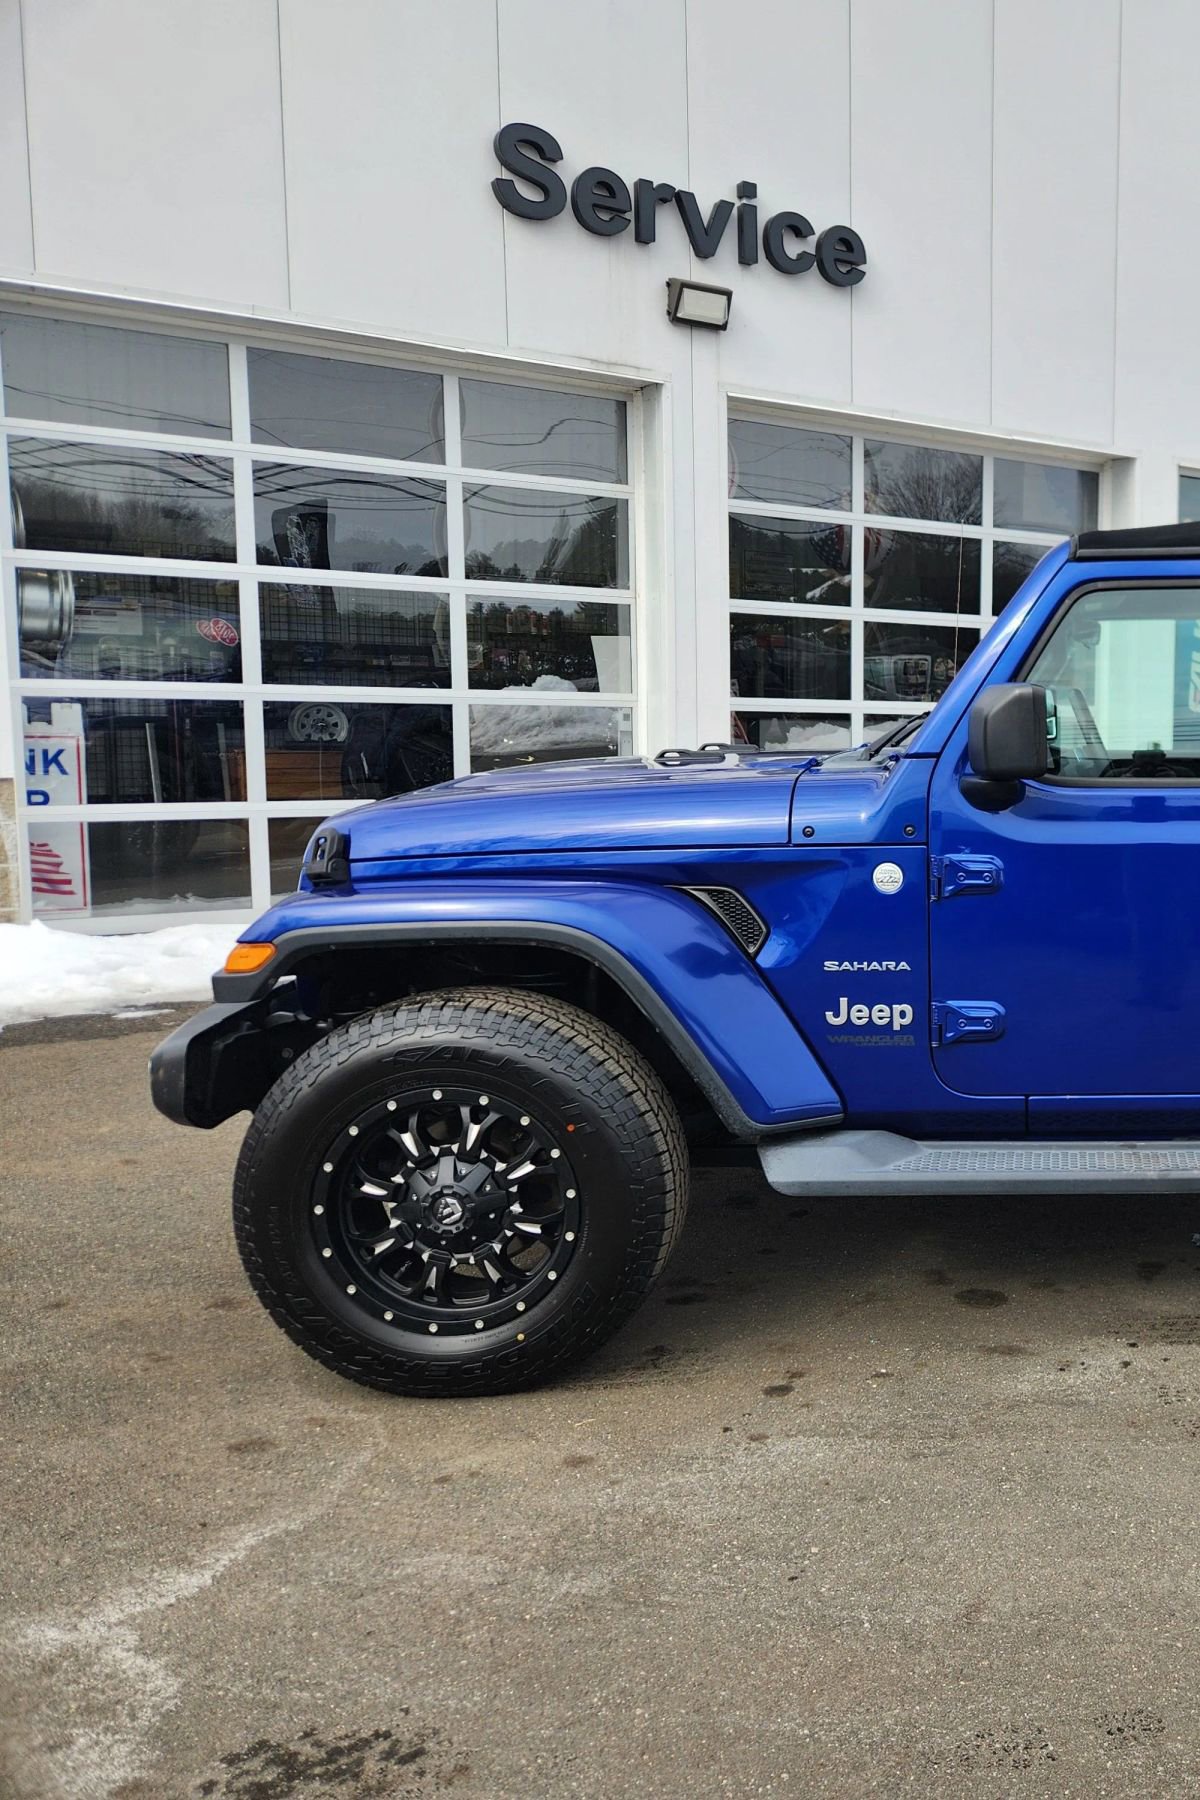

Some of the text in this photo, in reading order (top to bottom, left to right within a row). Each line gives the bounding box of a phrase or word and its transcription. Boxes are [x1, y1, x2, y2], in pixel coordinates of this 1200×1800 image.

[490, 122, 868, 288] Service
[823, 961, 912, 972] SAHARA
[824, 997, 913, 1031] Jeep
[826, 1034, 914, 1043] WRANGLER
